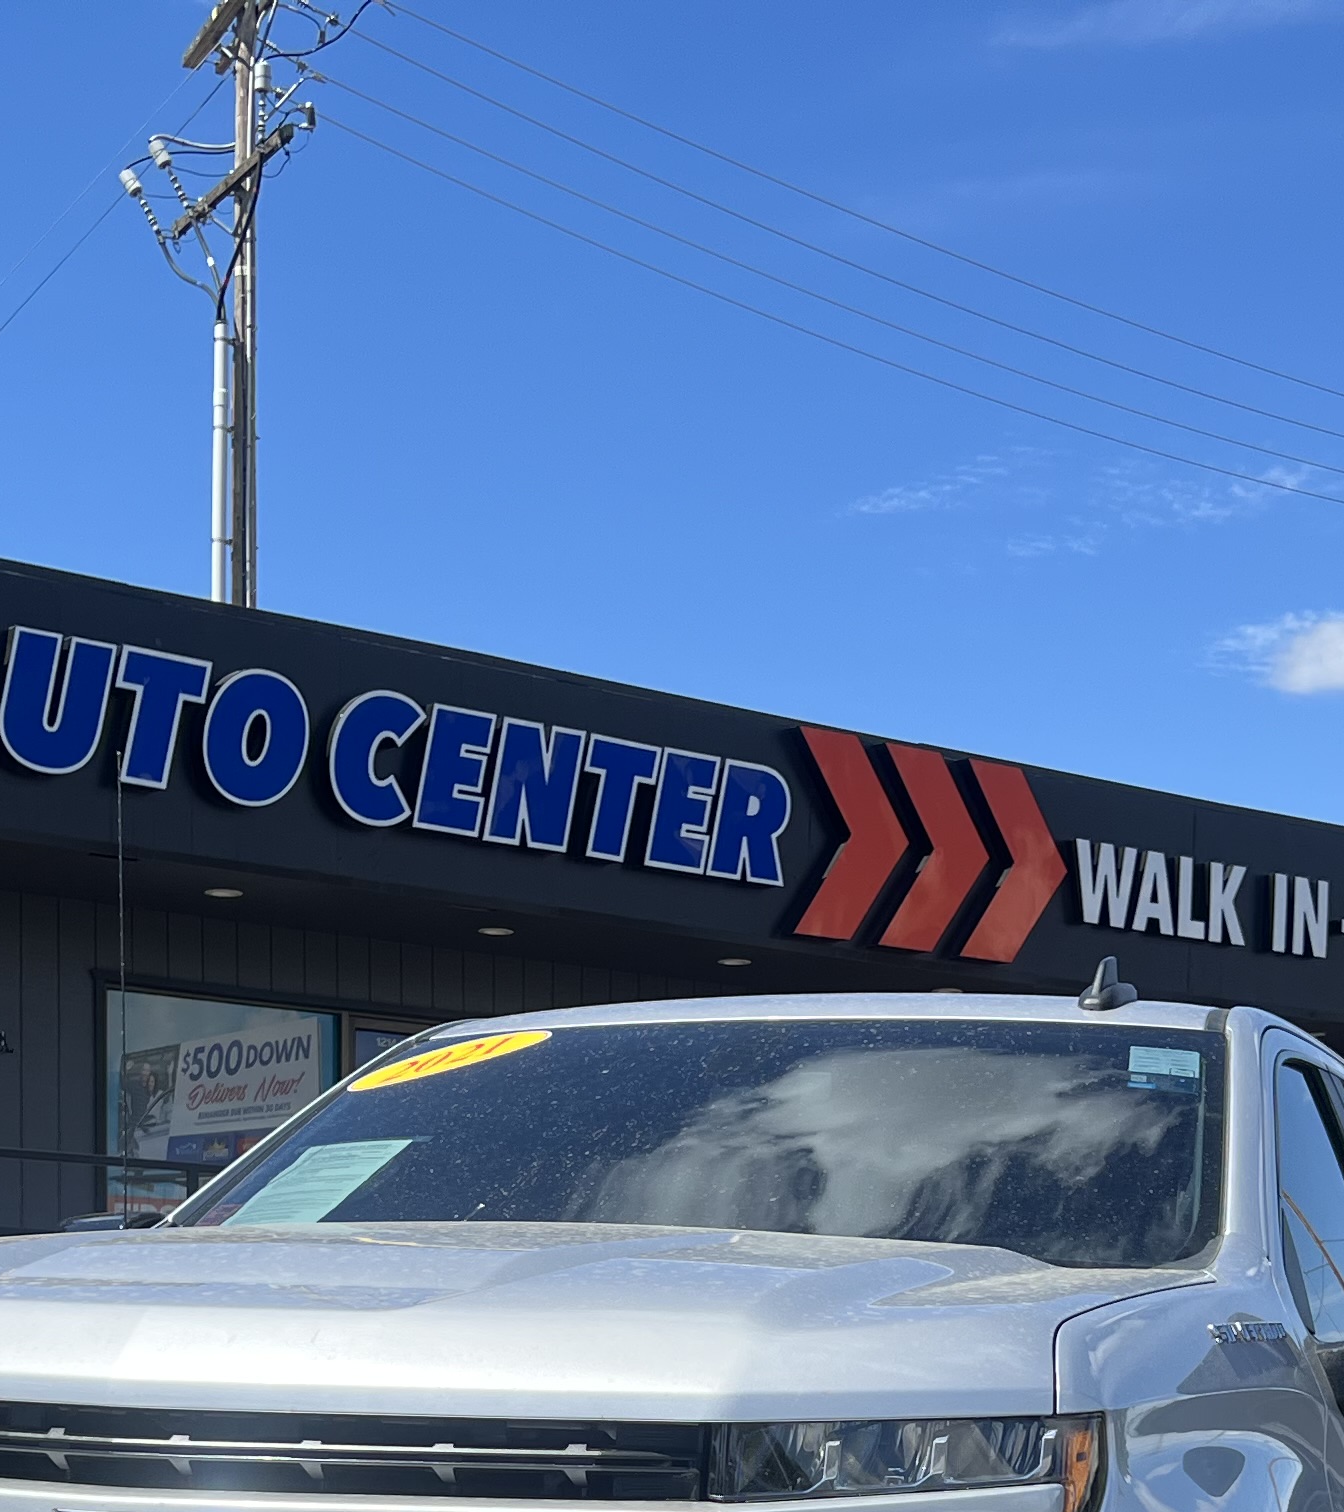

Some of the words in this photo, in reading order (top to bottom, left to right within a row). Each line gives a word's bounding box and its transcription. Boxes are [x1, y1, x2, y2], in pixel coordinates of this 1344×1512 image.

[328, 690, 793, 888] CENTER
[1074, 838, 1248, 947] WALK
[181, 1039, 244, 1082] $500
[244, 1034, 313, 1069] DOWN
[379, 1036, 515, 1083] 2021
[186, 1082, 248, 1111] Delivers
[256, 1071, 306, 1102] Now!
